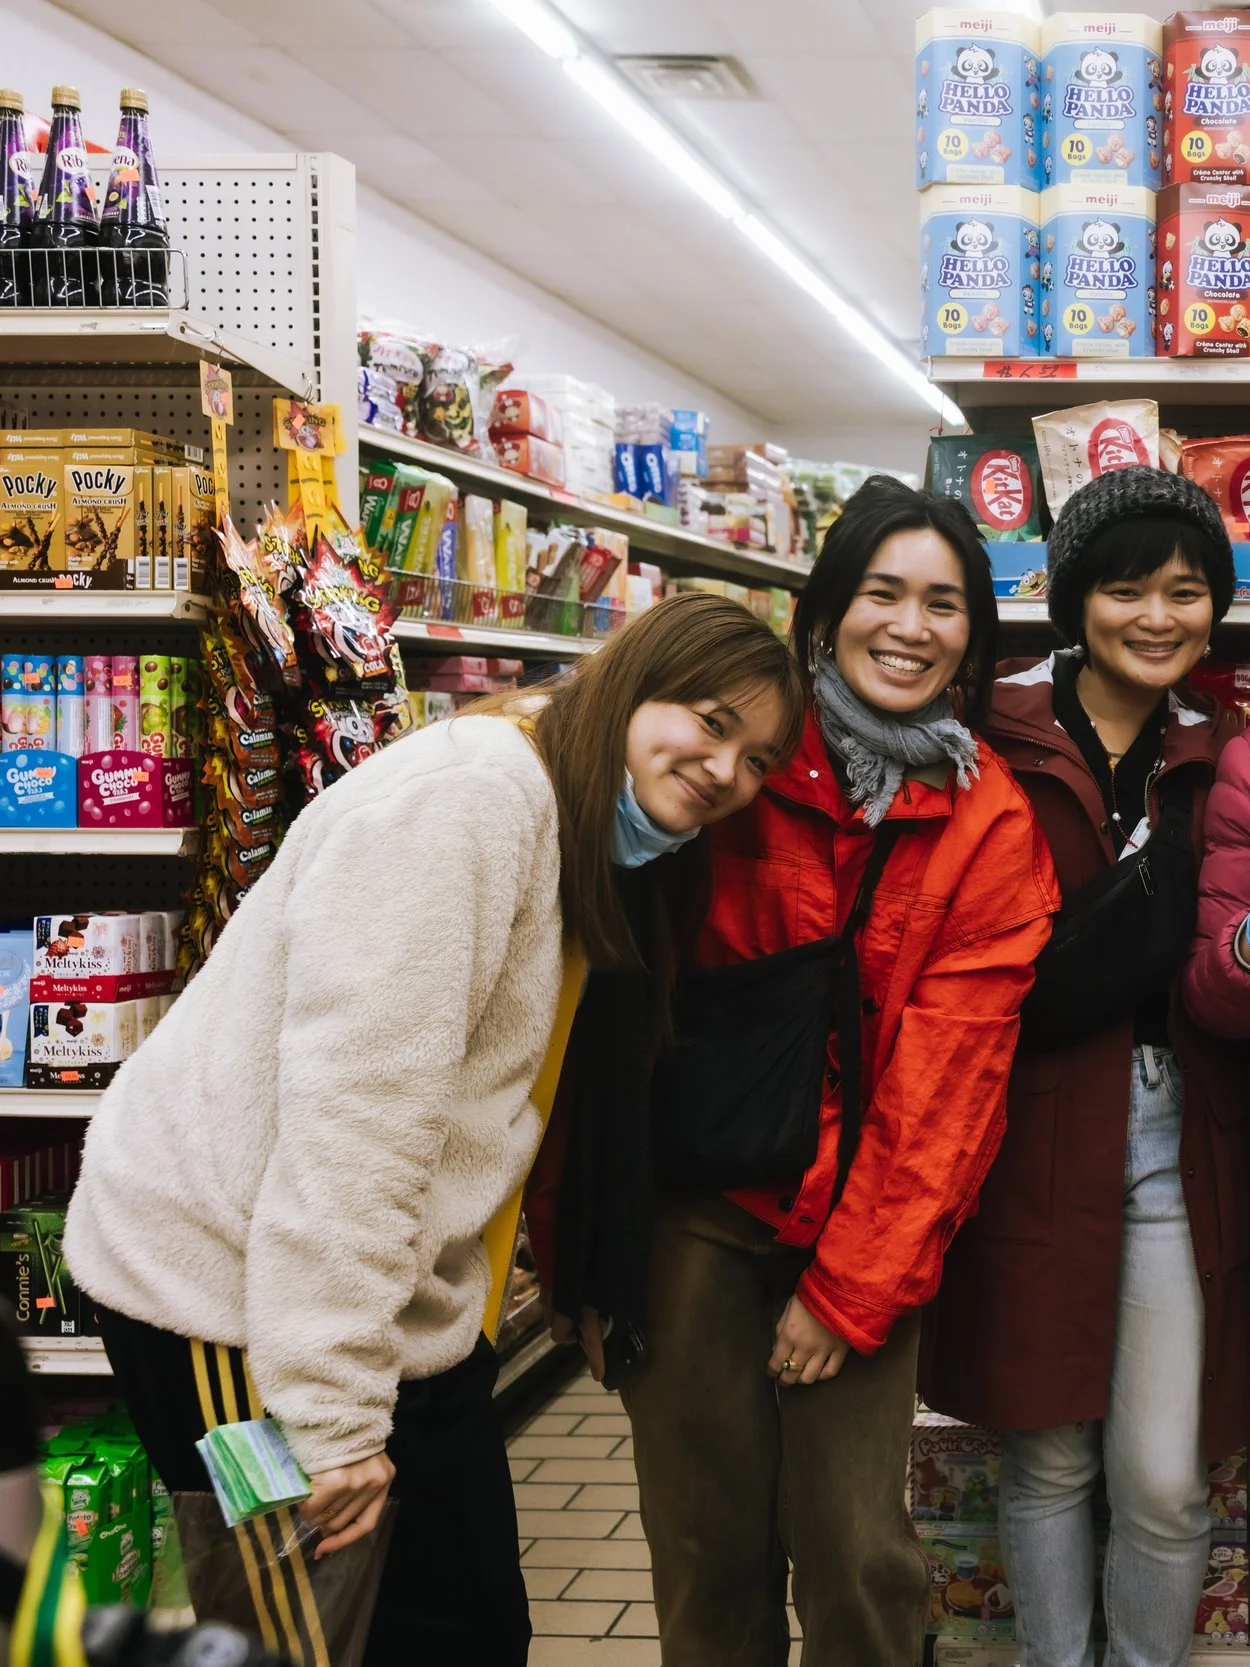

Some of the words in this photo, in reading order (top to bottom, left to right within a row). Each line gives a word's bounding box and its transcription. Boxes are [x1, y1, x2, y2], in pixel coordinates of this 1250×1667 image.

[960, 20, 992, 31] meiji
[1084, 23, 1116, 35] meiji
[1203, 18, 1238, 33] meiji
[943, 81, 1009, 101] HELLO
[1067, 84, 1133, 104] HELLO
[940, 97, 1011, 116] PANDA
[1064, 101, 1136, 120] PANDA
[1200, 117, 1238, 125] Chocolate
[945, 135, 961, 148] 10
[1069, 140, 1084, 152] 10
[1188, 138, 1204, 150] 10
[943, 147, 962, 156] Bags
[1068, 152, 1086, 161] Bags
[1187, 150, 1205, 158] Bags
[960, 195, 992, 206] meiji
[1085, 195, 1118, 207] meiji
[1206, 192, 1241, 208] meiji
[942, 256, 1009, 273] HELLO
[1068, 256, 1135, 274] HELLO
[940, 271, 1011, 289] PANDA
[1065, 271, 1138, 289] PANDA
[944, 309, 960, 322] 10
[1071, 310, 1086, 322] 10
[1192, 309, 1208, 321] 10
[943, 322, 961, 330] Bags
[1069, 322, 1088, 330] Bags
[1190, 322, 1209, 330] Bags
[2, 472, 58, 498] Pocky
[72, 468, 126, 494] Pocky
[1, 501, 32, 510] ALMOND
[72, 497, 103, 505] ALMOND
[13, 575, 37, 584] ALMOND
[364, 660, 385, 673] COLA
[14, 778, 53, 796] CHOCO
[99, 780, 139, 797] CHOCO
[44, 956, 103, 972] Meltykiss
[52, 984, 88, 993] Meltykiss
[43, 1044, 103, 1059] Meltykiss
[16, 1252, 30, 1322] Connie's
